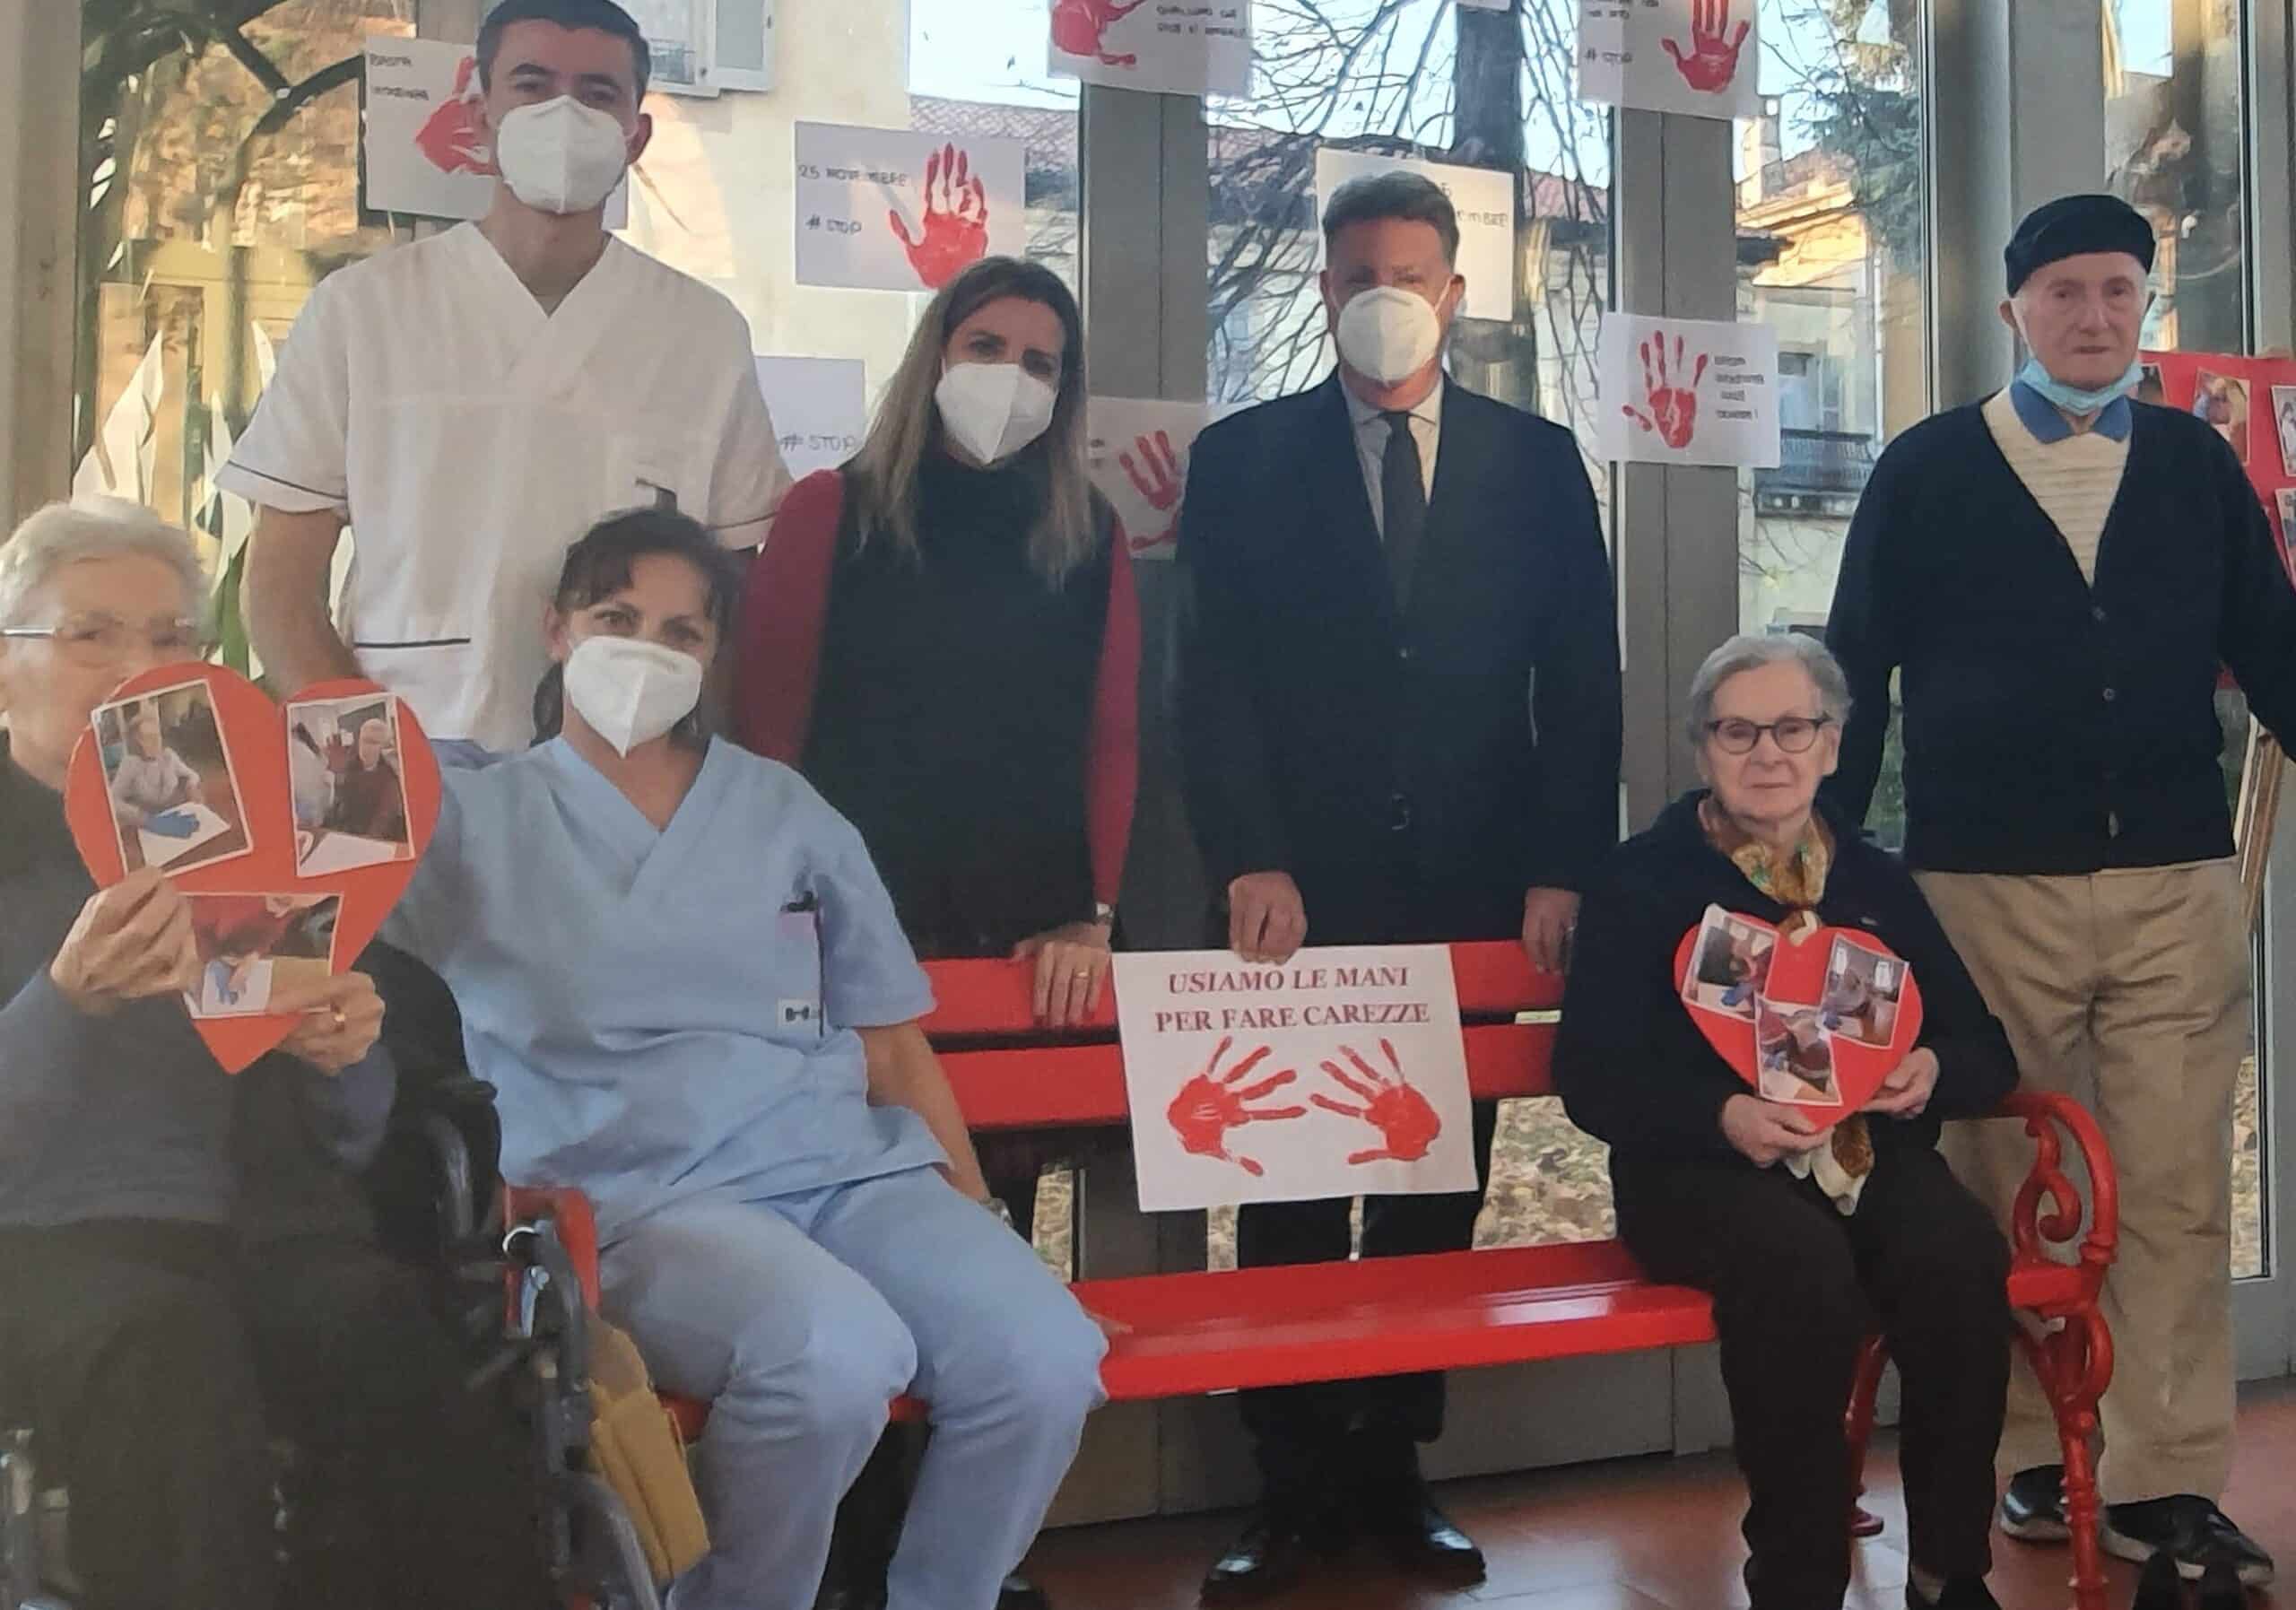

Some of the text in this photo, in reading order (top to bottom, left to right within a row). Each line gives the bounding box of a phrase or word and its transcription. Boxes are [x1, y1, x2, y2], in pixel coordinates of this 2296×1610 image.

[798, 164, 821, 180] 25
[808, 434, 856, 451] STOP
[1169, 966, 1408, 994] USIAMO LE MANI
[1155, 1003, 1431, 1031] PER FARE CAREZZE
